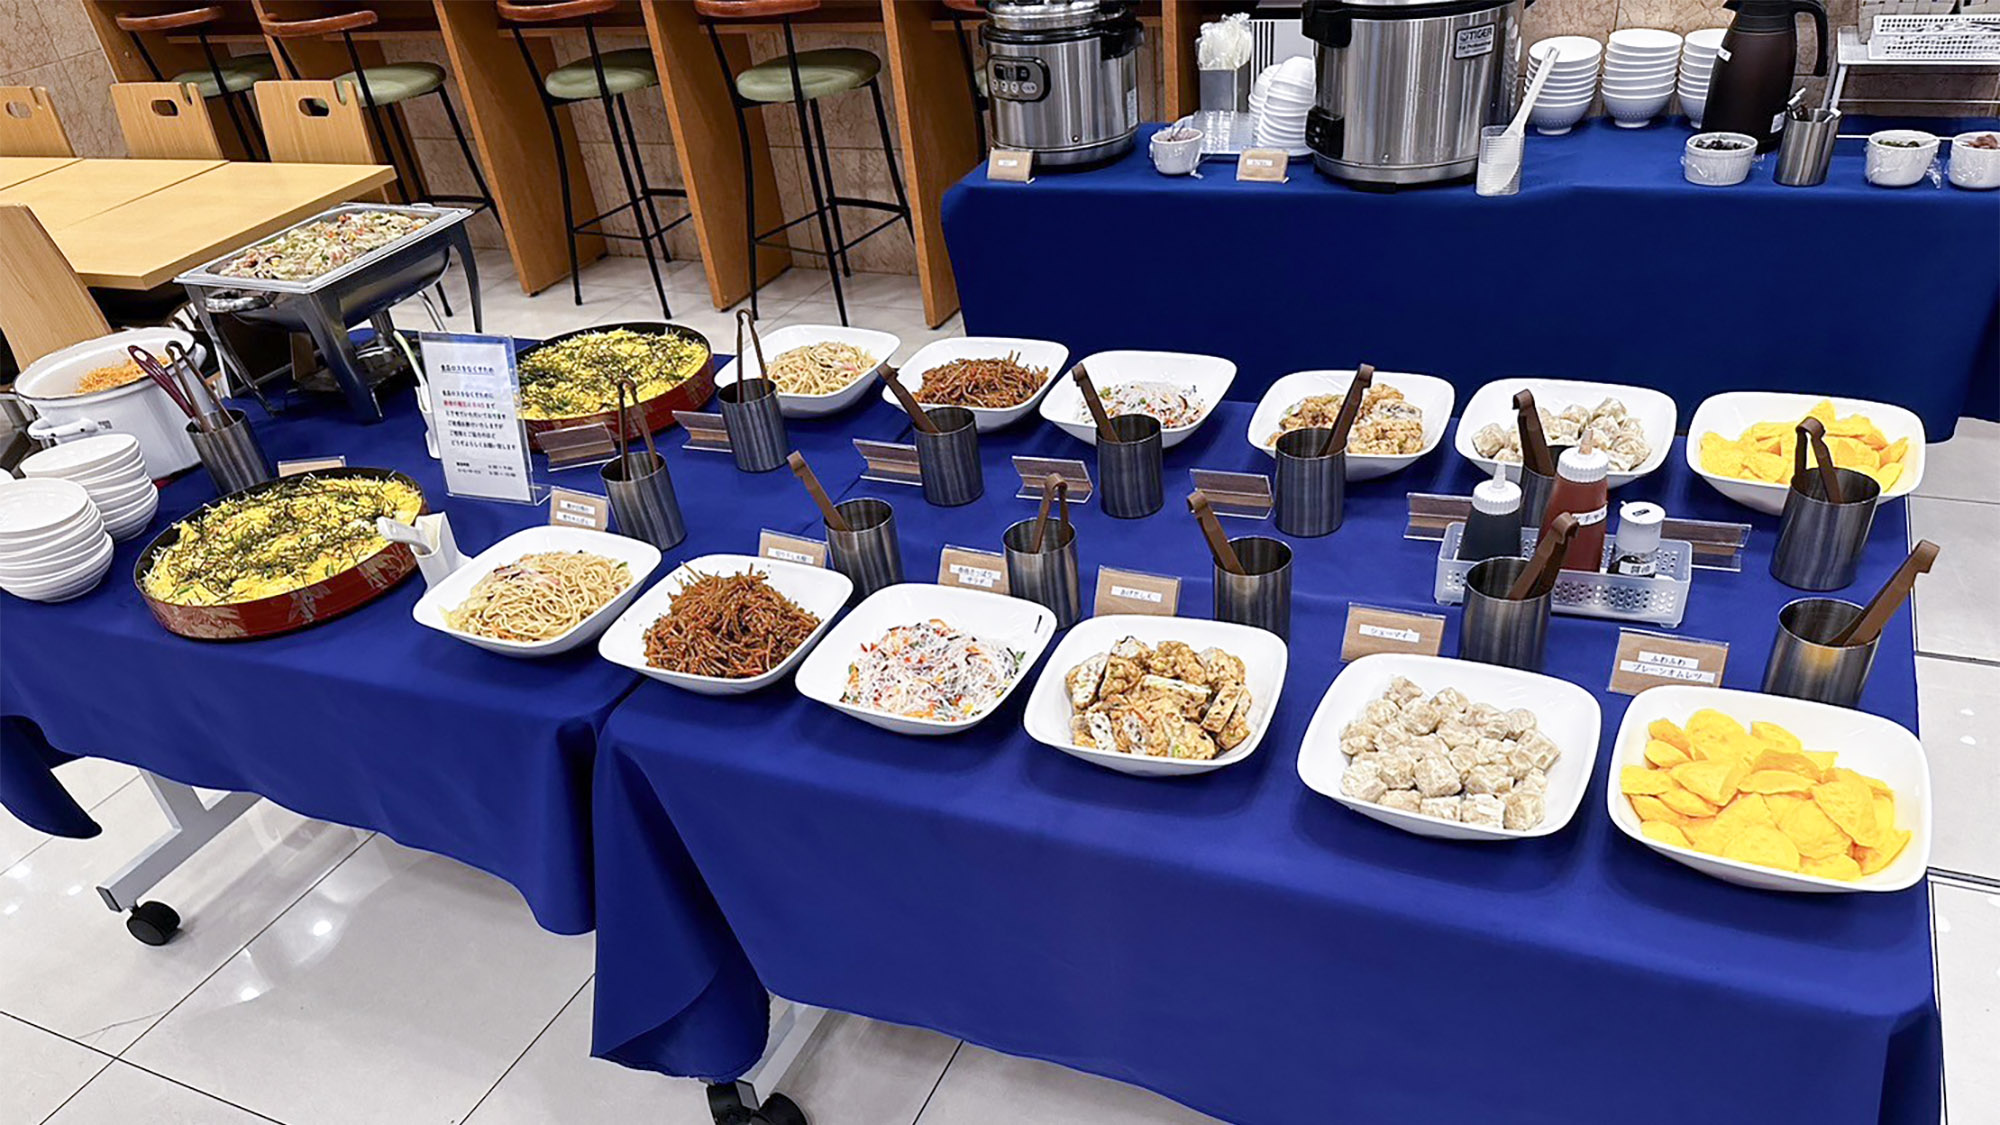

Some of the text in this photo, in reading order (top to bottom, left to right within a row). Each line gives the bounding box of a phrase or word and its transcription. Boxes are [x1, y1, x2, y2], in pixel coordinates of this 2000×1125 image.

[1371, 628, 1407, 639] シューマイ
[1650, 656, 1686, 666] ふわふわ
[1633, 663, 1702, 680] プレーンオムレツ
